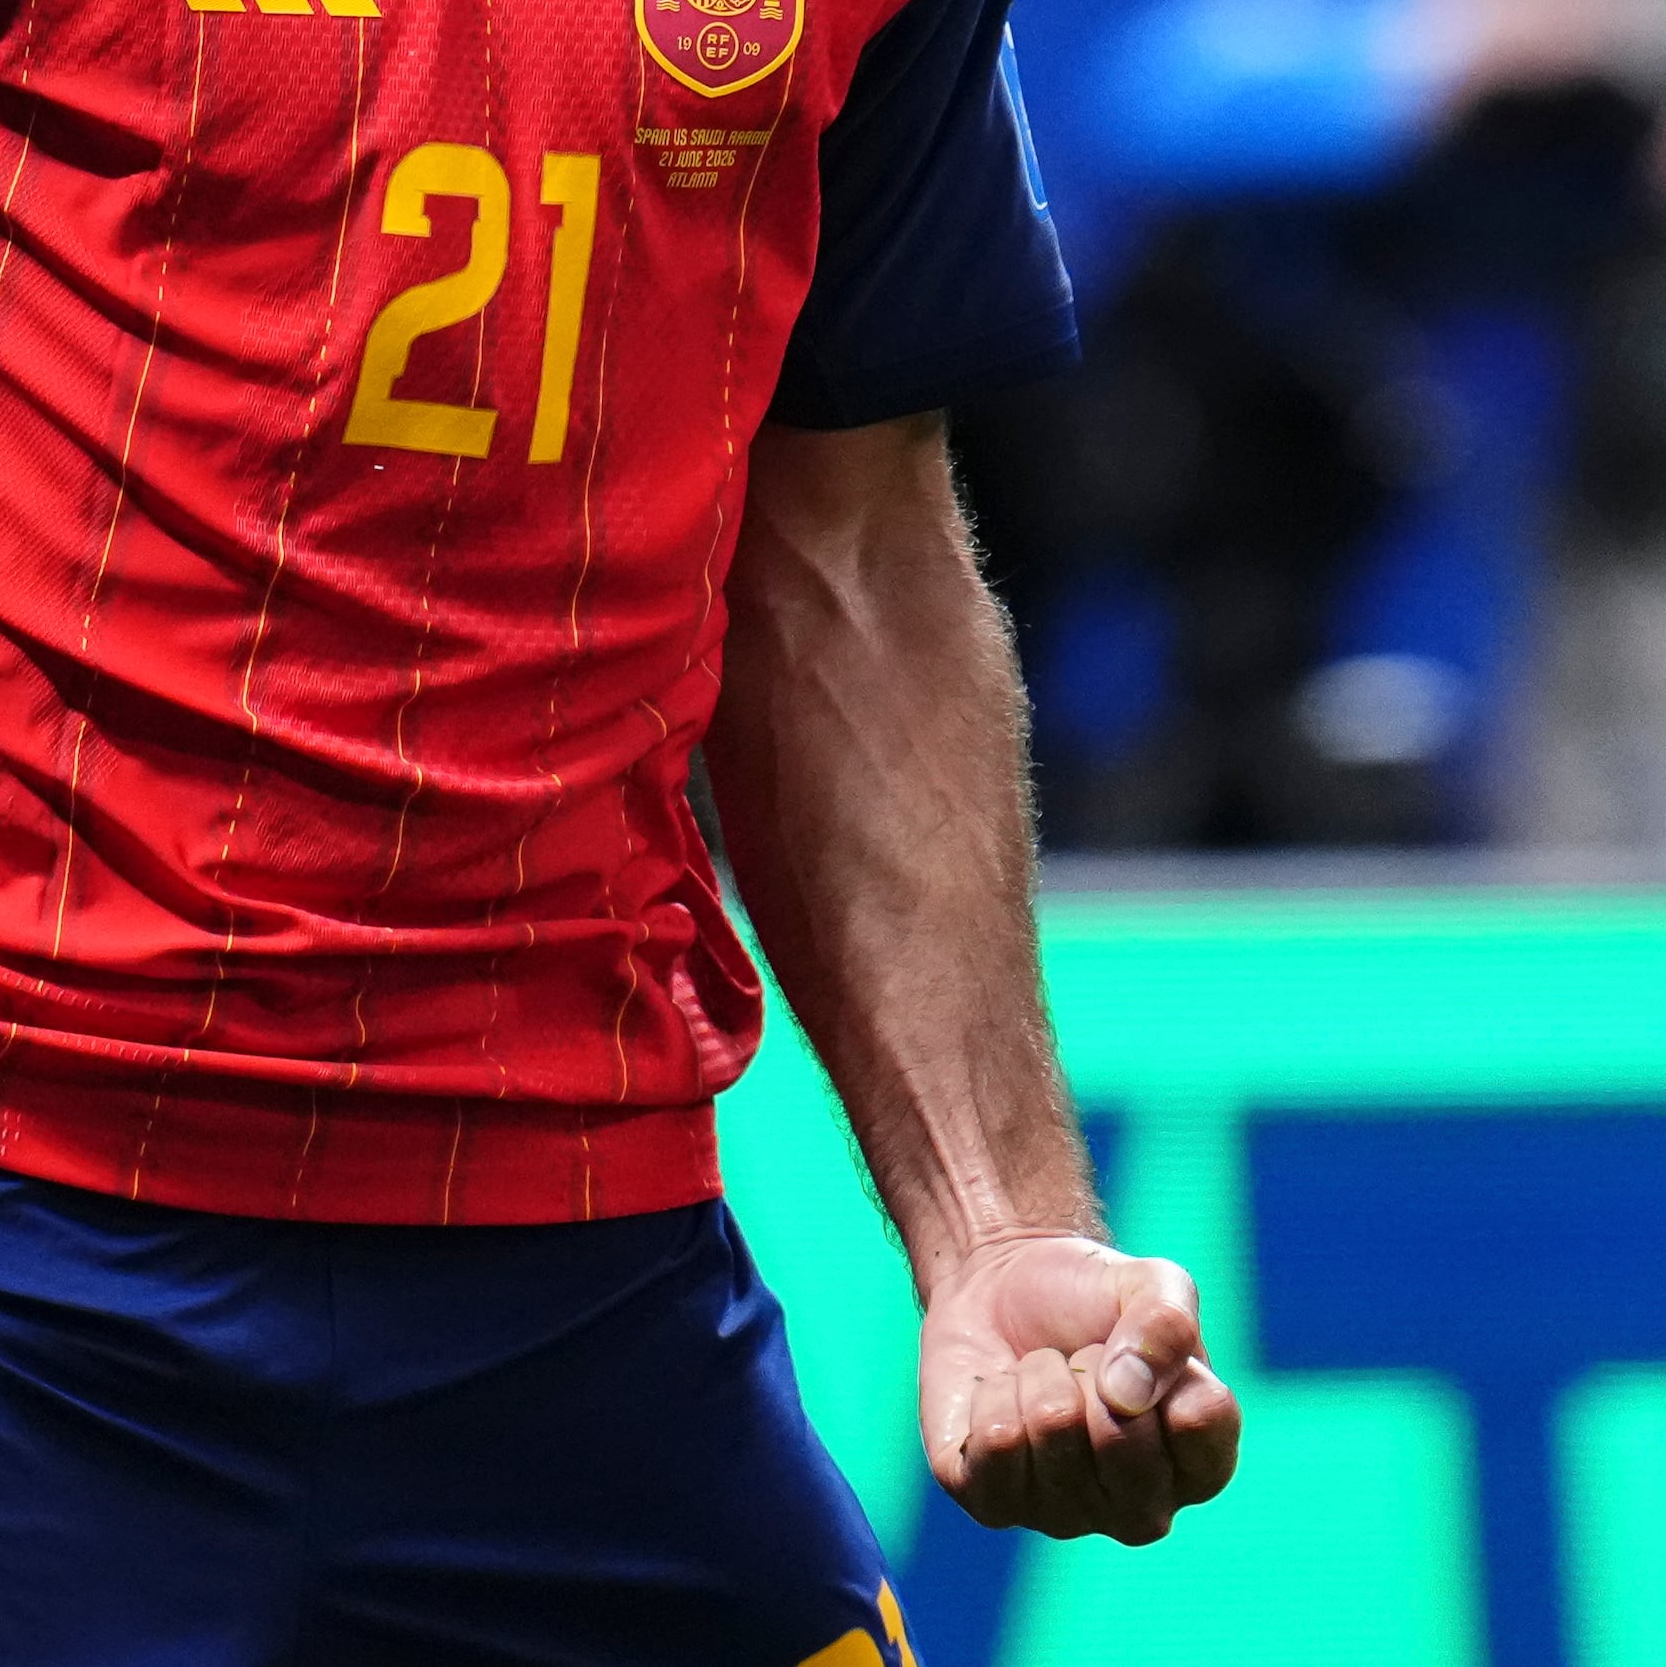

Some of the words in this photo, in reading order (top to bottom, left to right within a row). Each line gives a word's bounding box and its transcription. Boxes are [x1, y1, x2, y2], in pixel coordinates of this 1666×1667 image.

[677, 36, 692, 51] 19
[743, 41, 761, 56] 09
[706, 33, 730, 46] RF
[706, 46, 729, 59] EF
[635, 127, 671, 146] SPAIN
[690, 129, 727, 146] SAUDI
[659, 150, 674, 167] 21
[675, 150, 704, 168] JUNE
[706, 149, 737, 167] 2026
[666, 171, 719, 188] ATLANTA
[342, 141, 602, 465] 21
